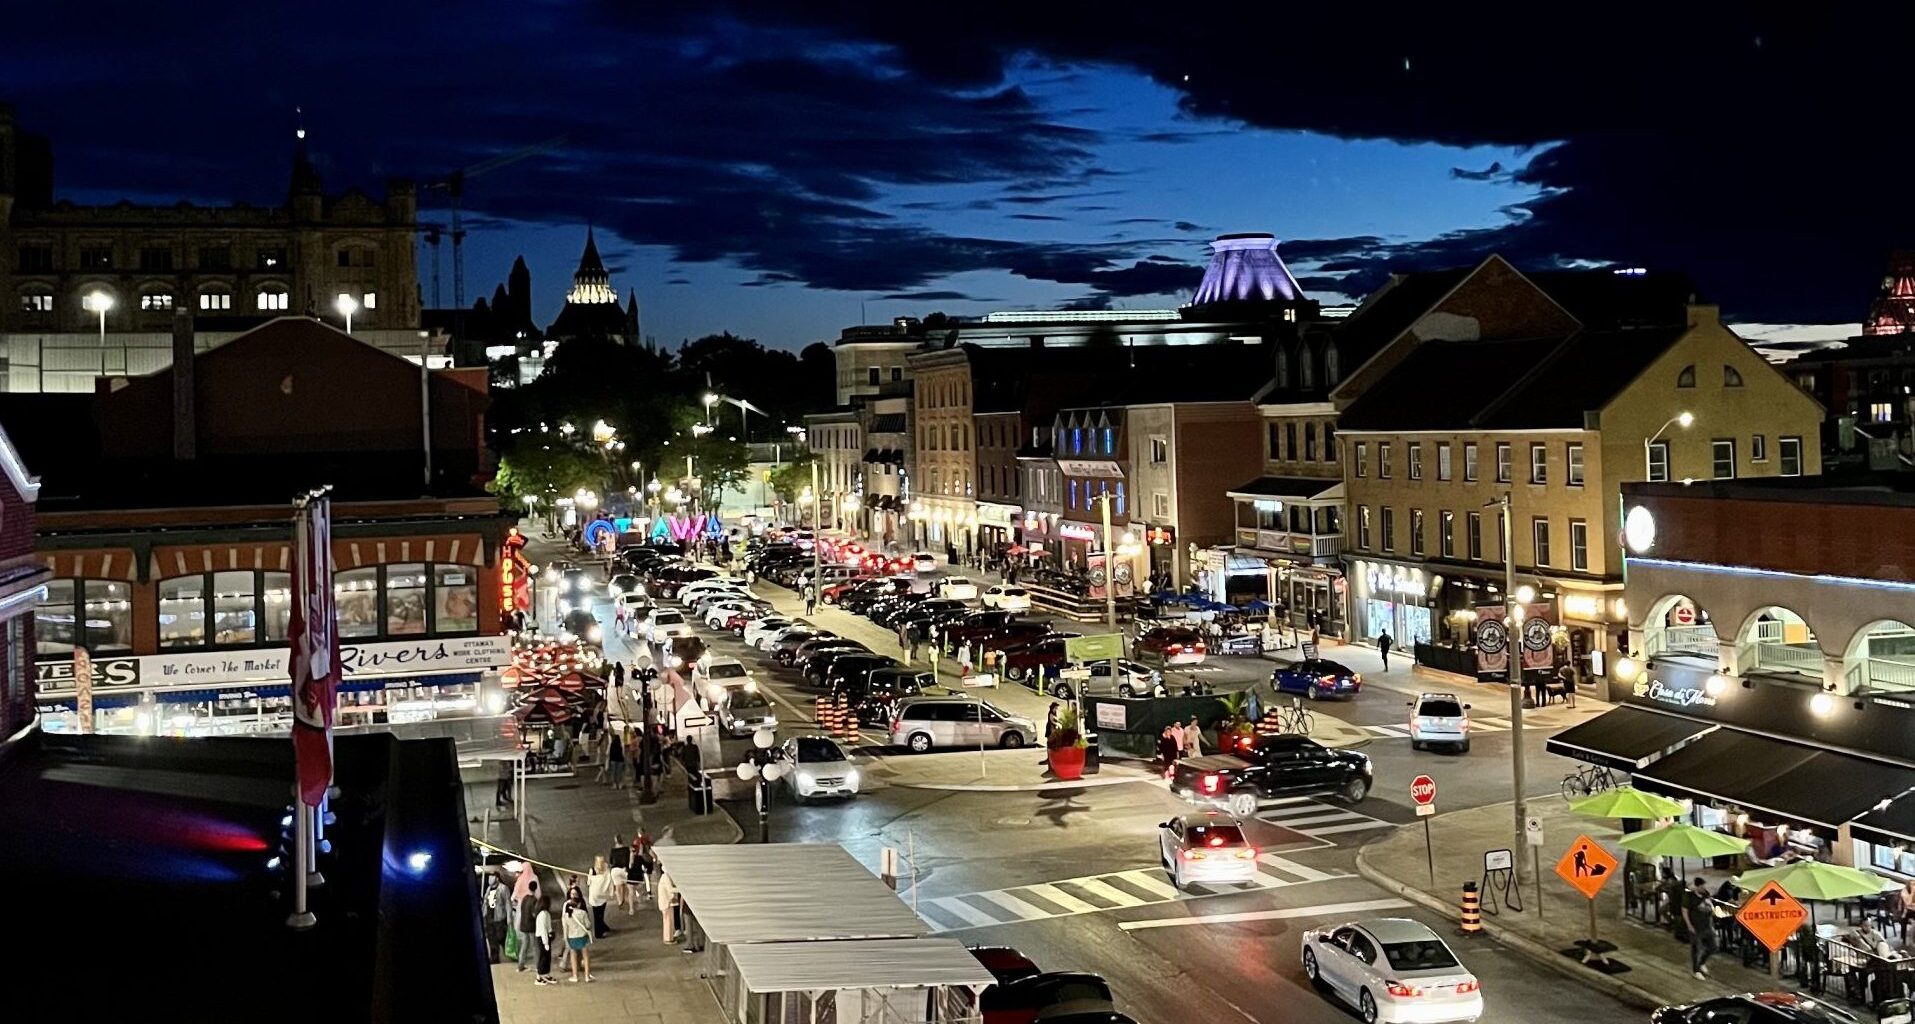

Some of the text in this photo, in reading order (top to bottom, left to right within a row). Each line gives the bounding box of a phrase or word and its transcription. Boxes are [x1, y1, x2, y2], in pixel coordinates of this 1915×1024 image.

[586, 514, 722, 546] OTTAWA
[502, 545, 513, 612] HOUSE
[163, 664, 178, 675] We
[185, 663, 216, 674] Corner
[244, 659, 280, 671] Market
[1412, 783, 1434, 797] STOP
[1743, 910, 1802, 920] CONSTRUCTION
